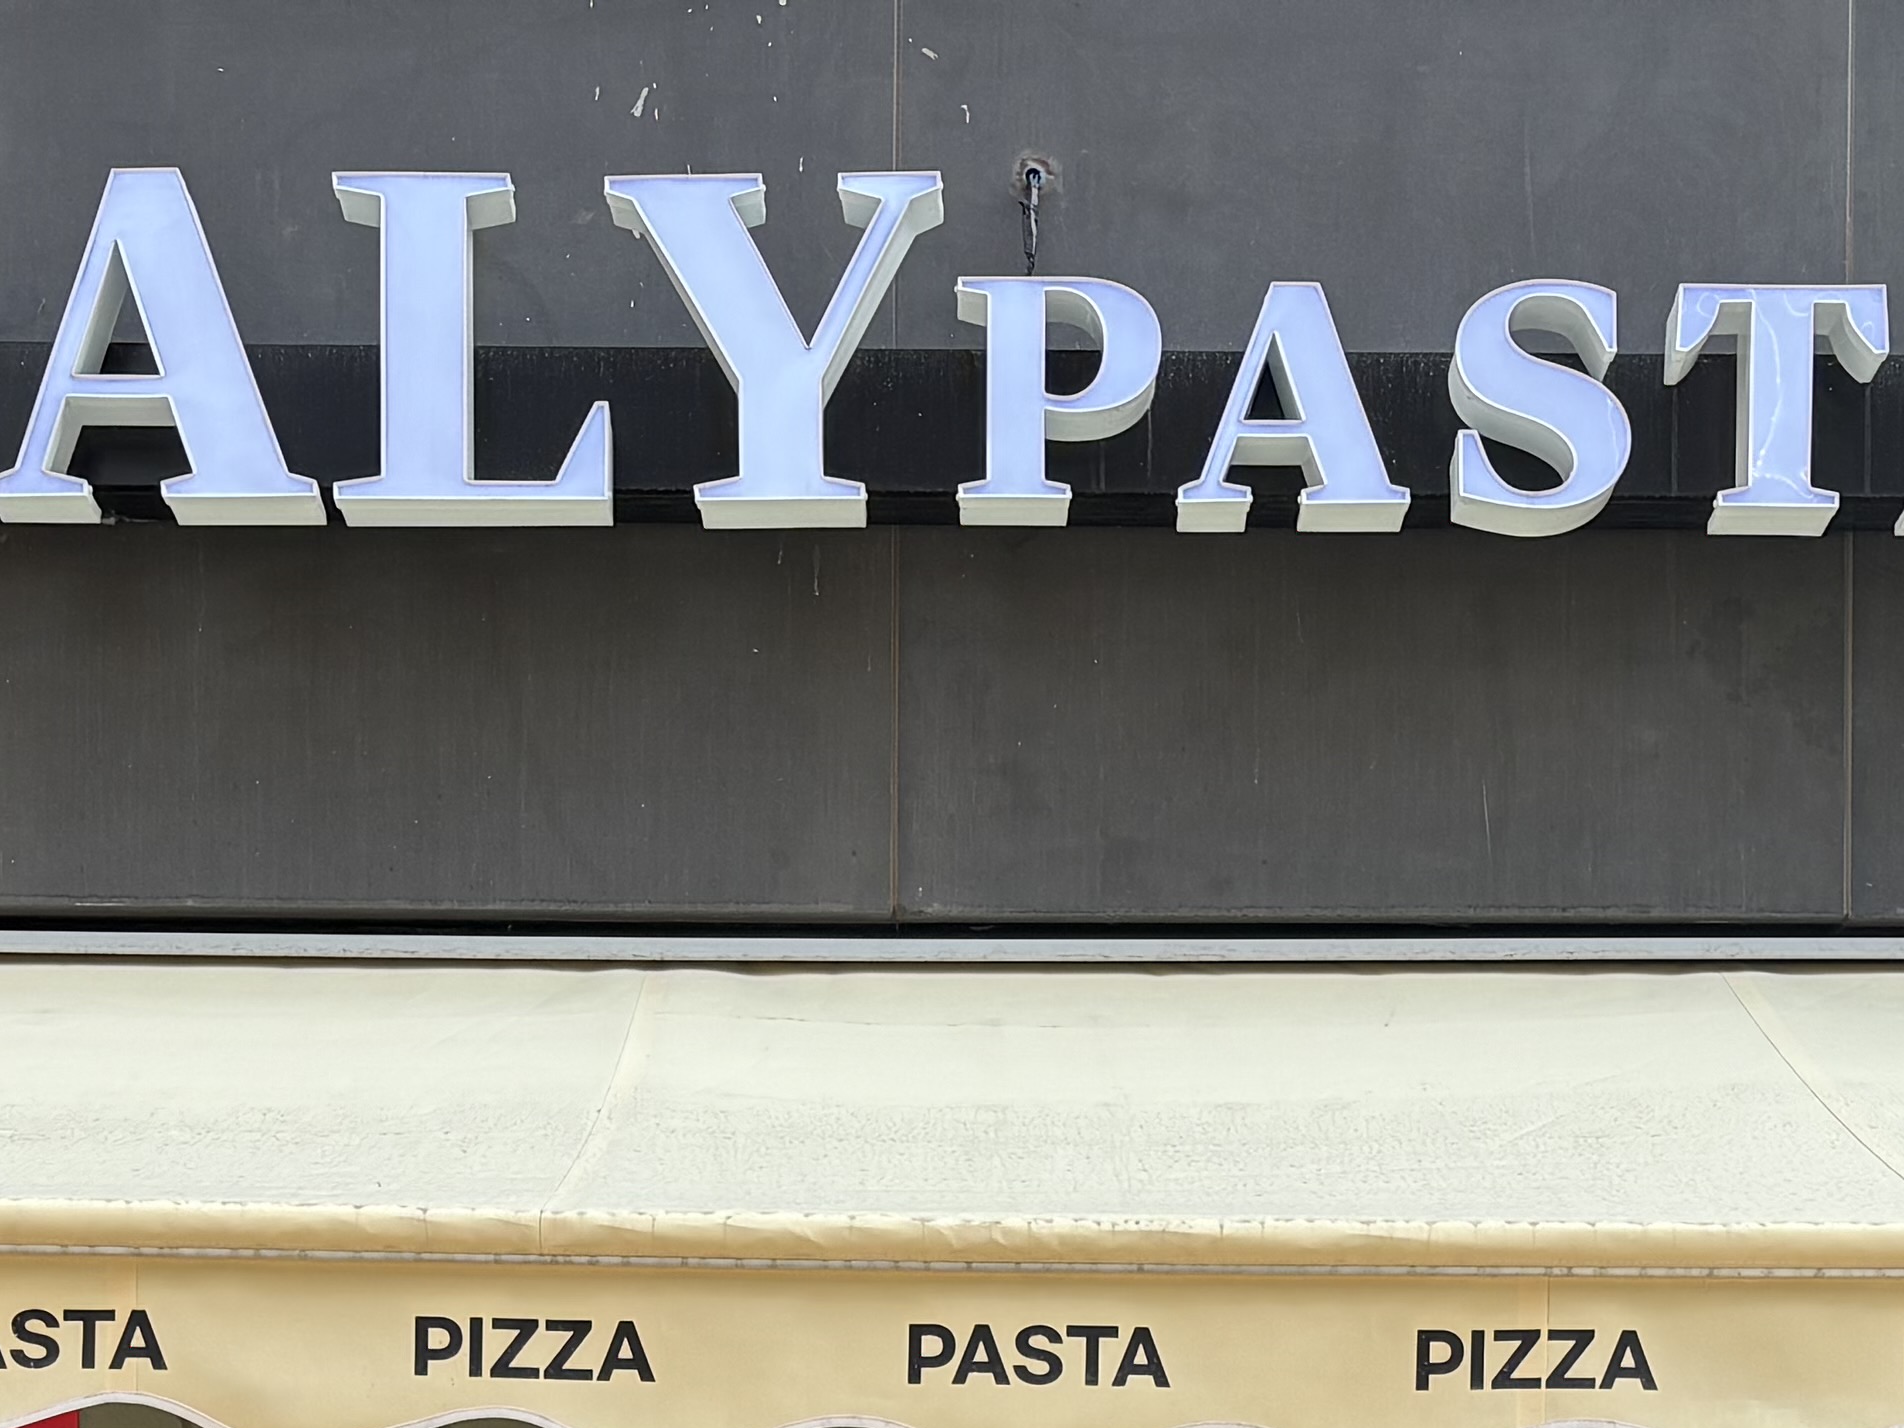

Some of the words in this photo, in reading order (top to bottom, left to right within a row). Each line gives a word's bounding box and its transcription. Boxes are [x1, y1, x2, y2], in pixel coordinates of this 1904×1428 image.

[412, 1315, 656, 1384] PIZZA
[906, 1322, 1170, 1389] PASTA
[1413, 1328, 1658, 1392] PIZZA
